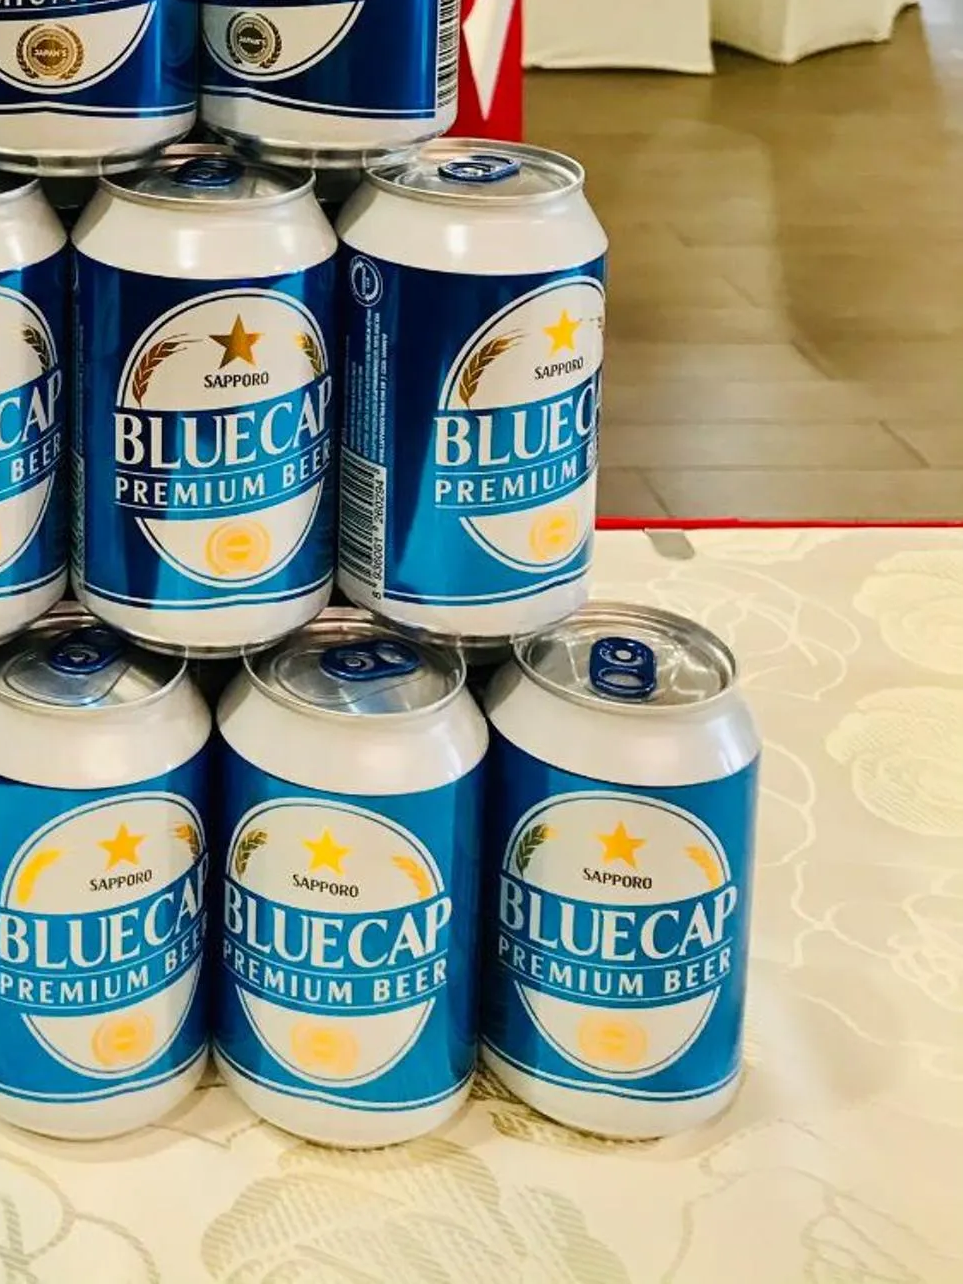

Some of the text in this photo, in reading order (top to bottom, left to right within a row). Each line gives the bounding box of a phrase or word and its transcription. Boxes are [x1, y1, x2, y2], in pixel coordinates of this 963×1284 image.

[204, 372, 269, 389] SAPPORO
[534, 356, 583, 380] SAPPORO
[113, 375, 333, 470] BLUECAP
[434, 376, 598, 467] BLUEC
[11, 432, 61, 483] BEER
[115, 438, 330, 506] PREMIUM BEER
[435, 454, 577, 504] PREMIUM
[89, 869, 152, 892] SAPPORO
[293, 874, 358, 898] SAPPORO
[583, 867, 652, 890] SAPPORO
[223, 880, 452, 969] BLUECAP
[499, 873, 737, 962] BLUECAP
[0, 965, 149, 1004] PREMIUM
[223, 942, 447, 1005] PREMIUM BEER
[498, 935, 731, 998] PREMIUM BEER
